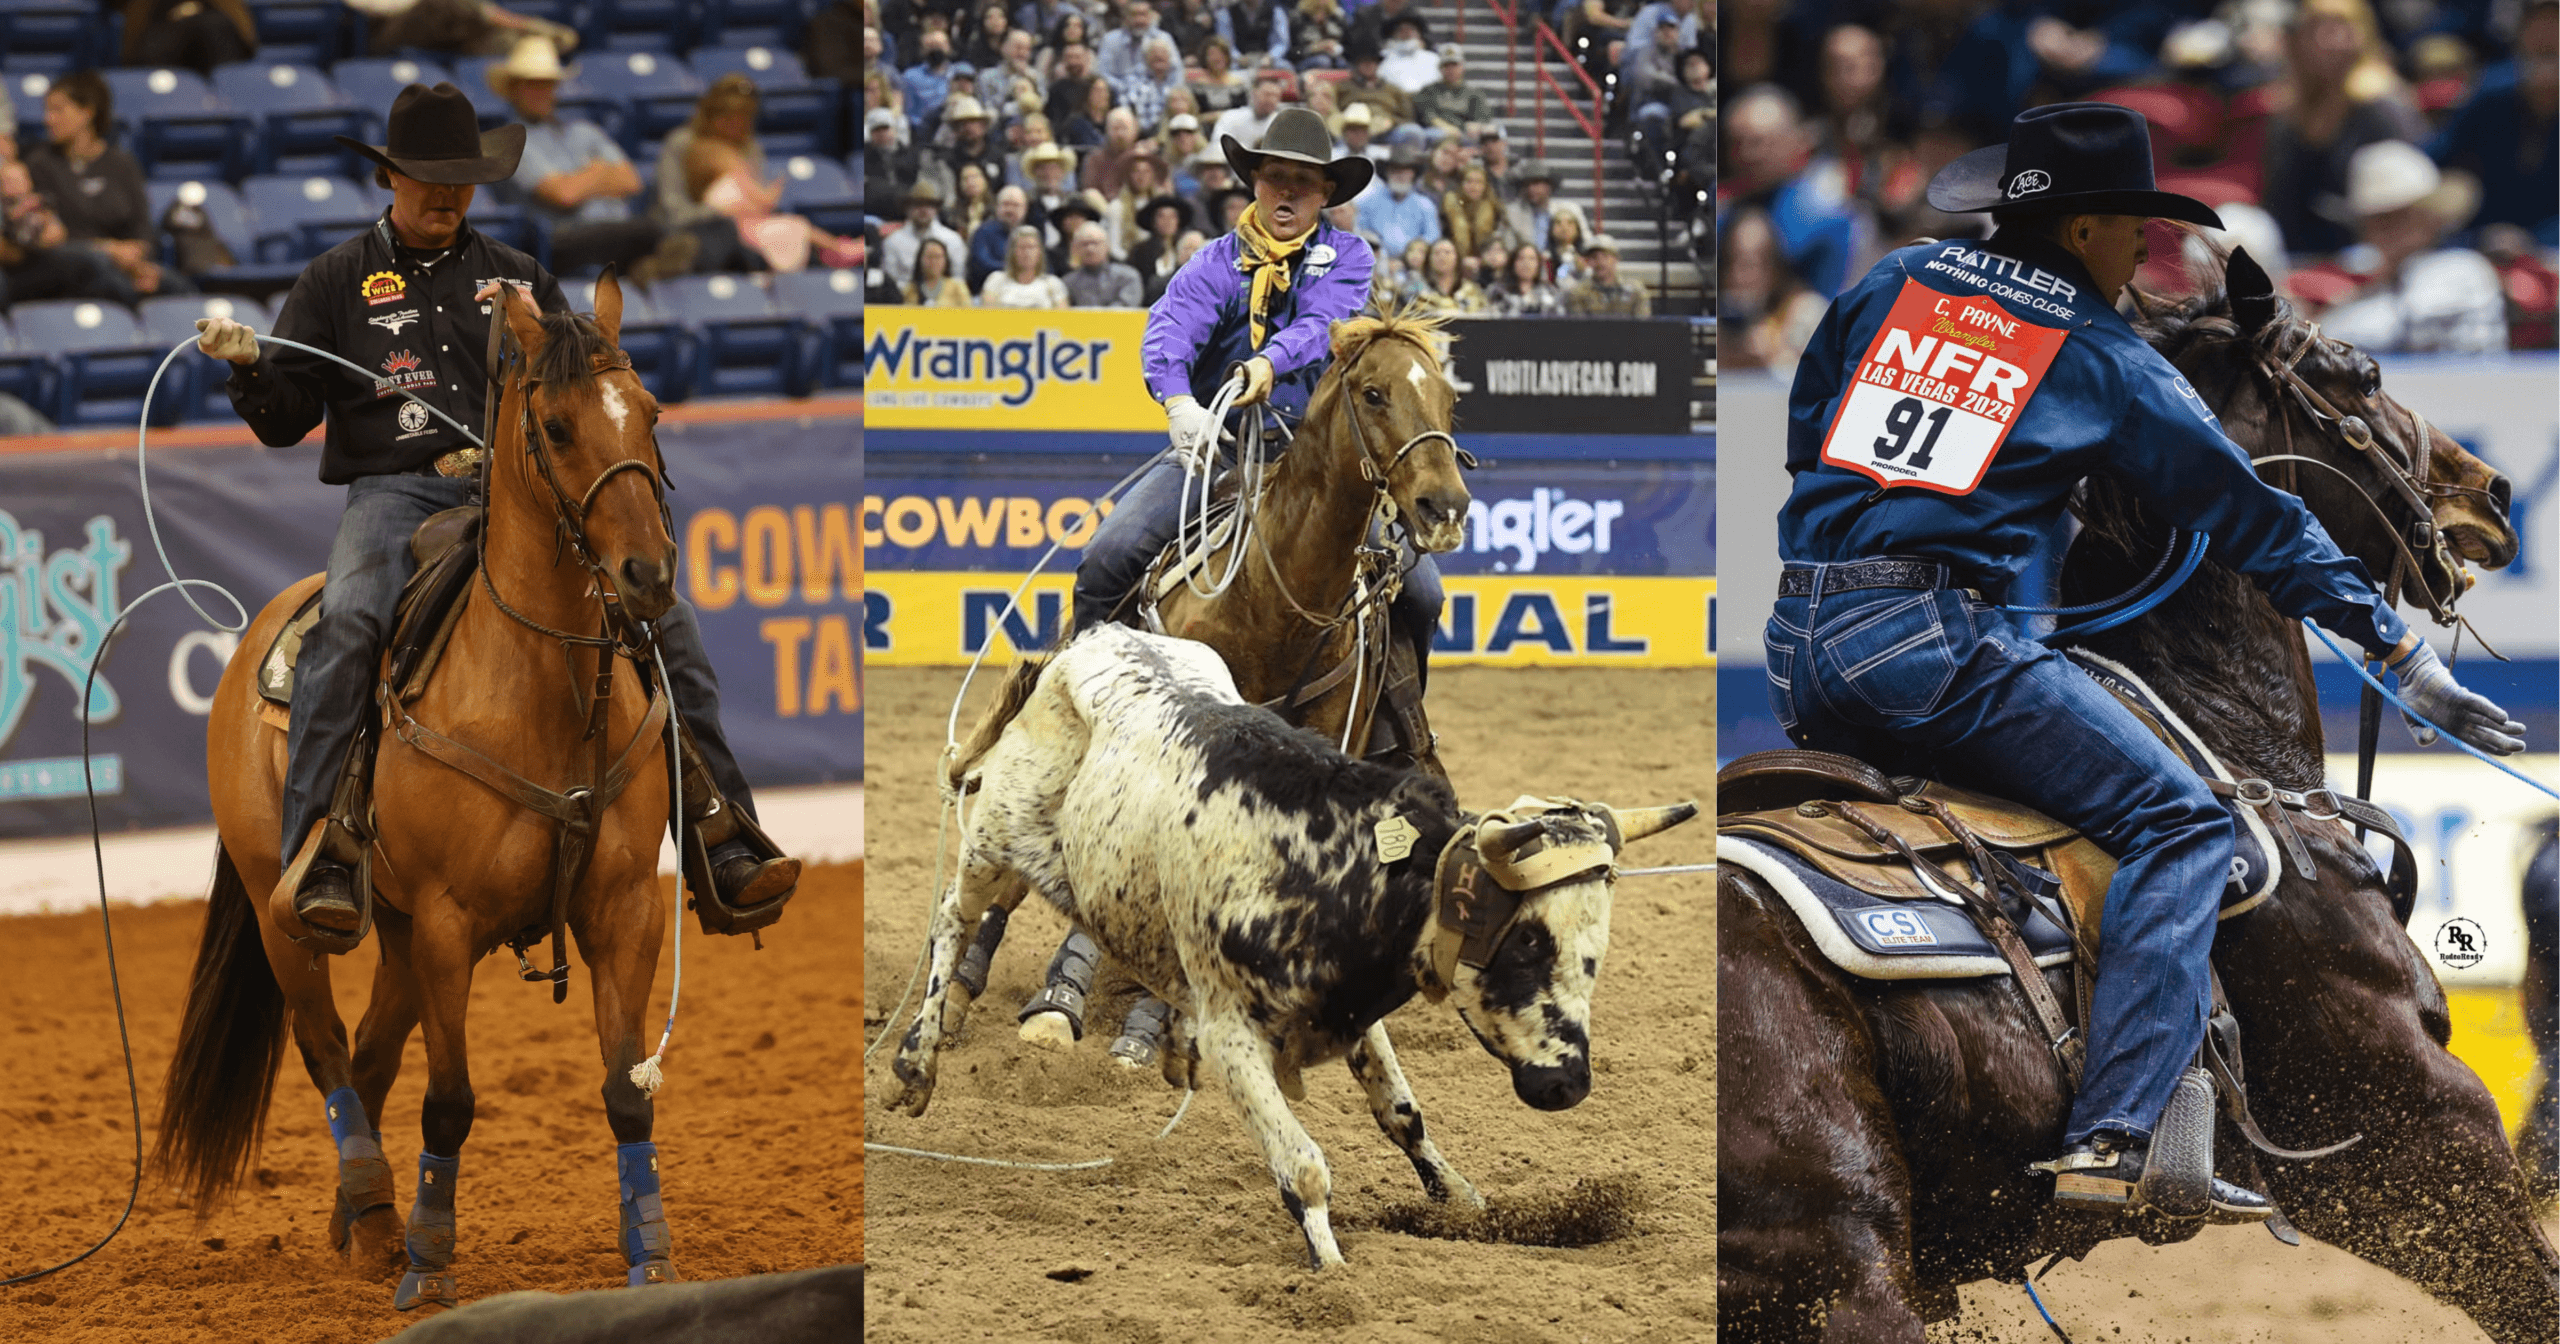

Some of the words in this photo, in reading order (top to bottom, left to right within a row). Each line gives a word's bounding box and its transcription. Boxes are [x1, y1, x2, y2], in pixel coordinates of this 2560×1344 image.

[371, 284, 396, 295] WIZE
[1925, 260, 1988, 288] NOTHING
[1988, 282, 2033, 305] COMES
[2032, 297, 2076, 321] CLOSE
[1939, 246, 2077, 303] RATTLER
[1932, 316, 1996, 351] Wrangler
[1934, 298, 1949, 316] C.
[1959, 305, 2021, 339] PAYNE
[404, 370, 435, 383] EVER
[864, 328, 1109, 406] Wrangler
[1486, 360, 1657, 396] VISITLASVEGAS.COM
[1873, 327, 2029, 405] NFR
[1859, 362, 1897, 387] LAS
[1900, 371, 1959, 404] VEGAS
[1960, 390, 2014, 423] 2024
[1873, 396, 1953, 470] 91
[864, 496, 1115, 549] COWBO
[1867, 911, 1930, 936] CSI
[1881, 936, 1908, 944] ELITE
[1908, 935, 1933, 943] TEAM
